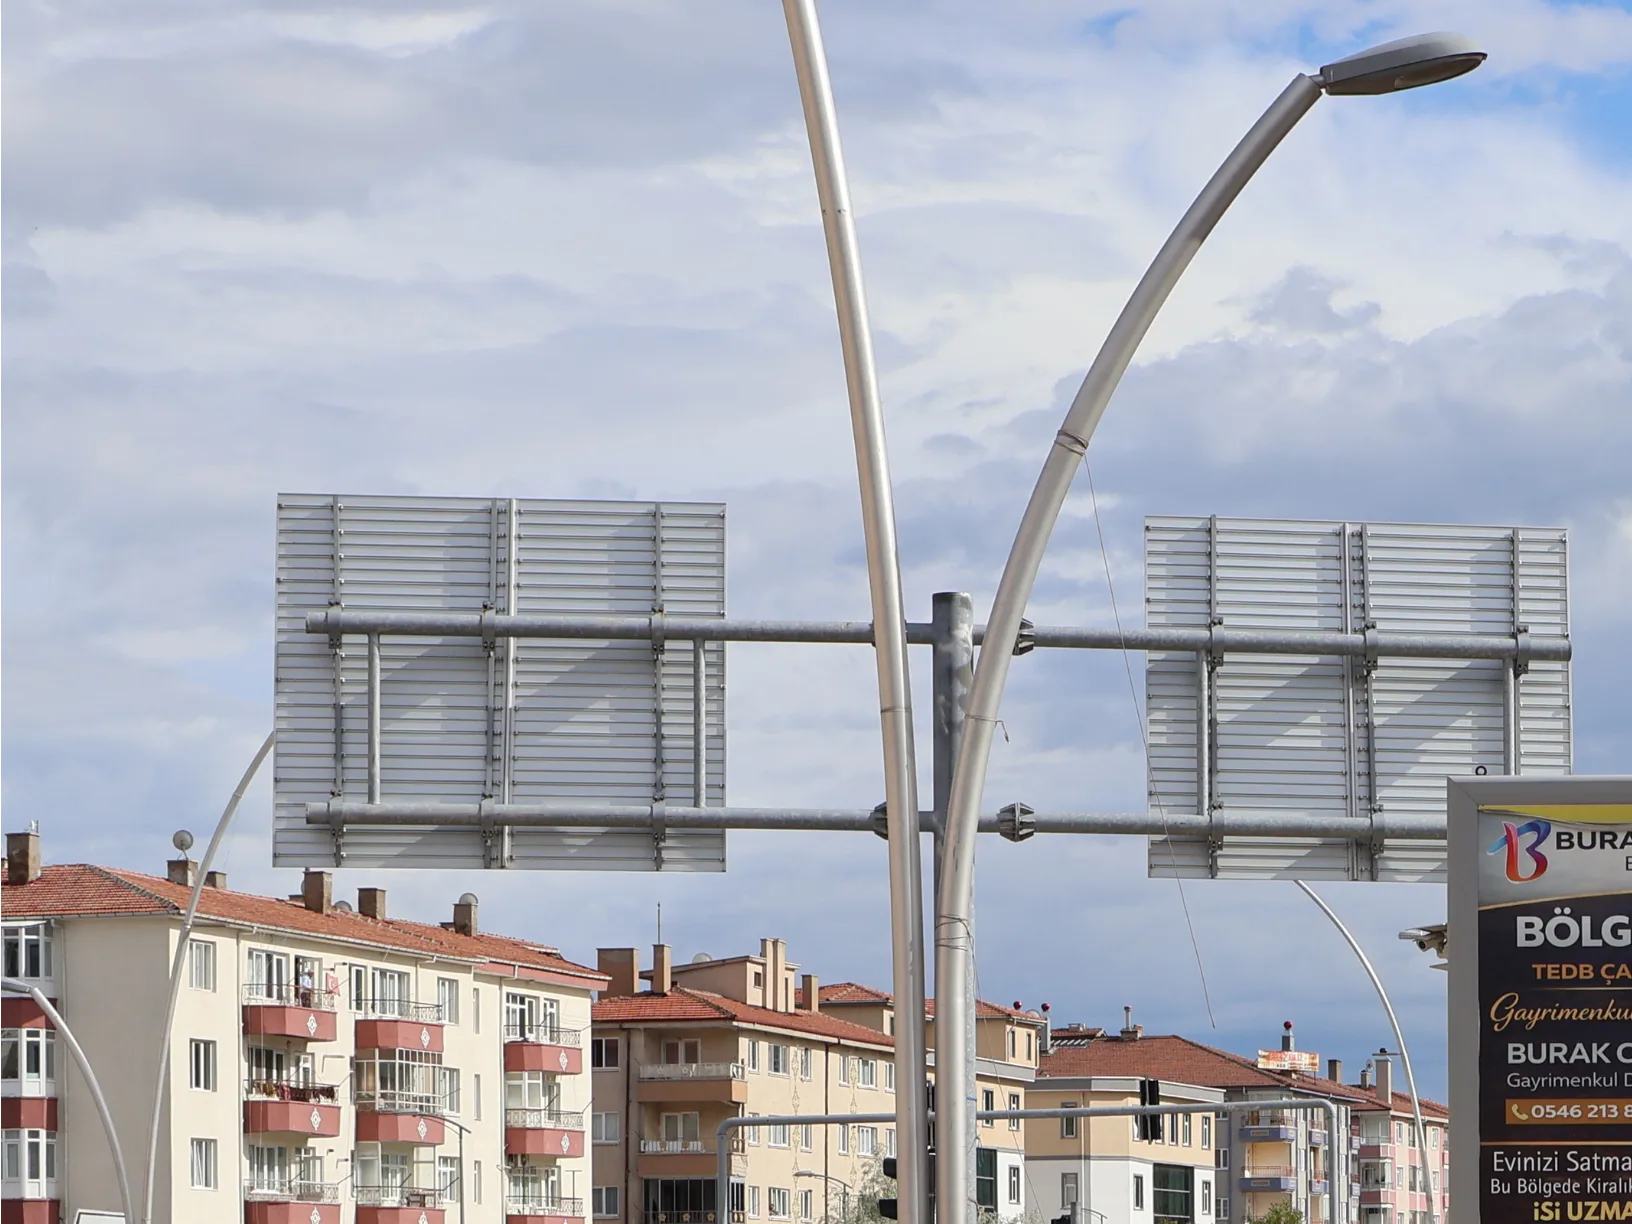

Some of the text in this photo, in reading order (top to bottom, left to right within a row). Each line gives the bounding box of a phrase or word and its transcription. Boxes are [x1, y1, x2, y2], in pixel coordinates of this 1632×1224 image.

[1532, 964, 1595, 980] TEDB
[1507, 1042, 1612, 1065] BURAK
[1507, 1072, 1619, 1092] Gayrimenkul
[1531, 1104, 1583, 1119] 0546
[1587, 1104, 1619, 1118] 213
[1493, 1151, 1558, 1172] Evinizi
[1490, 1178, 1511, 1194] Bu
[1517, 1178, 1581, 1198] Bölgede
